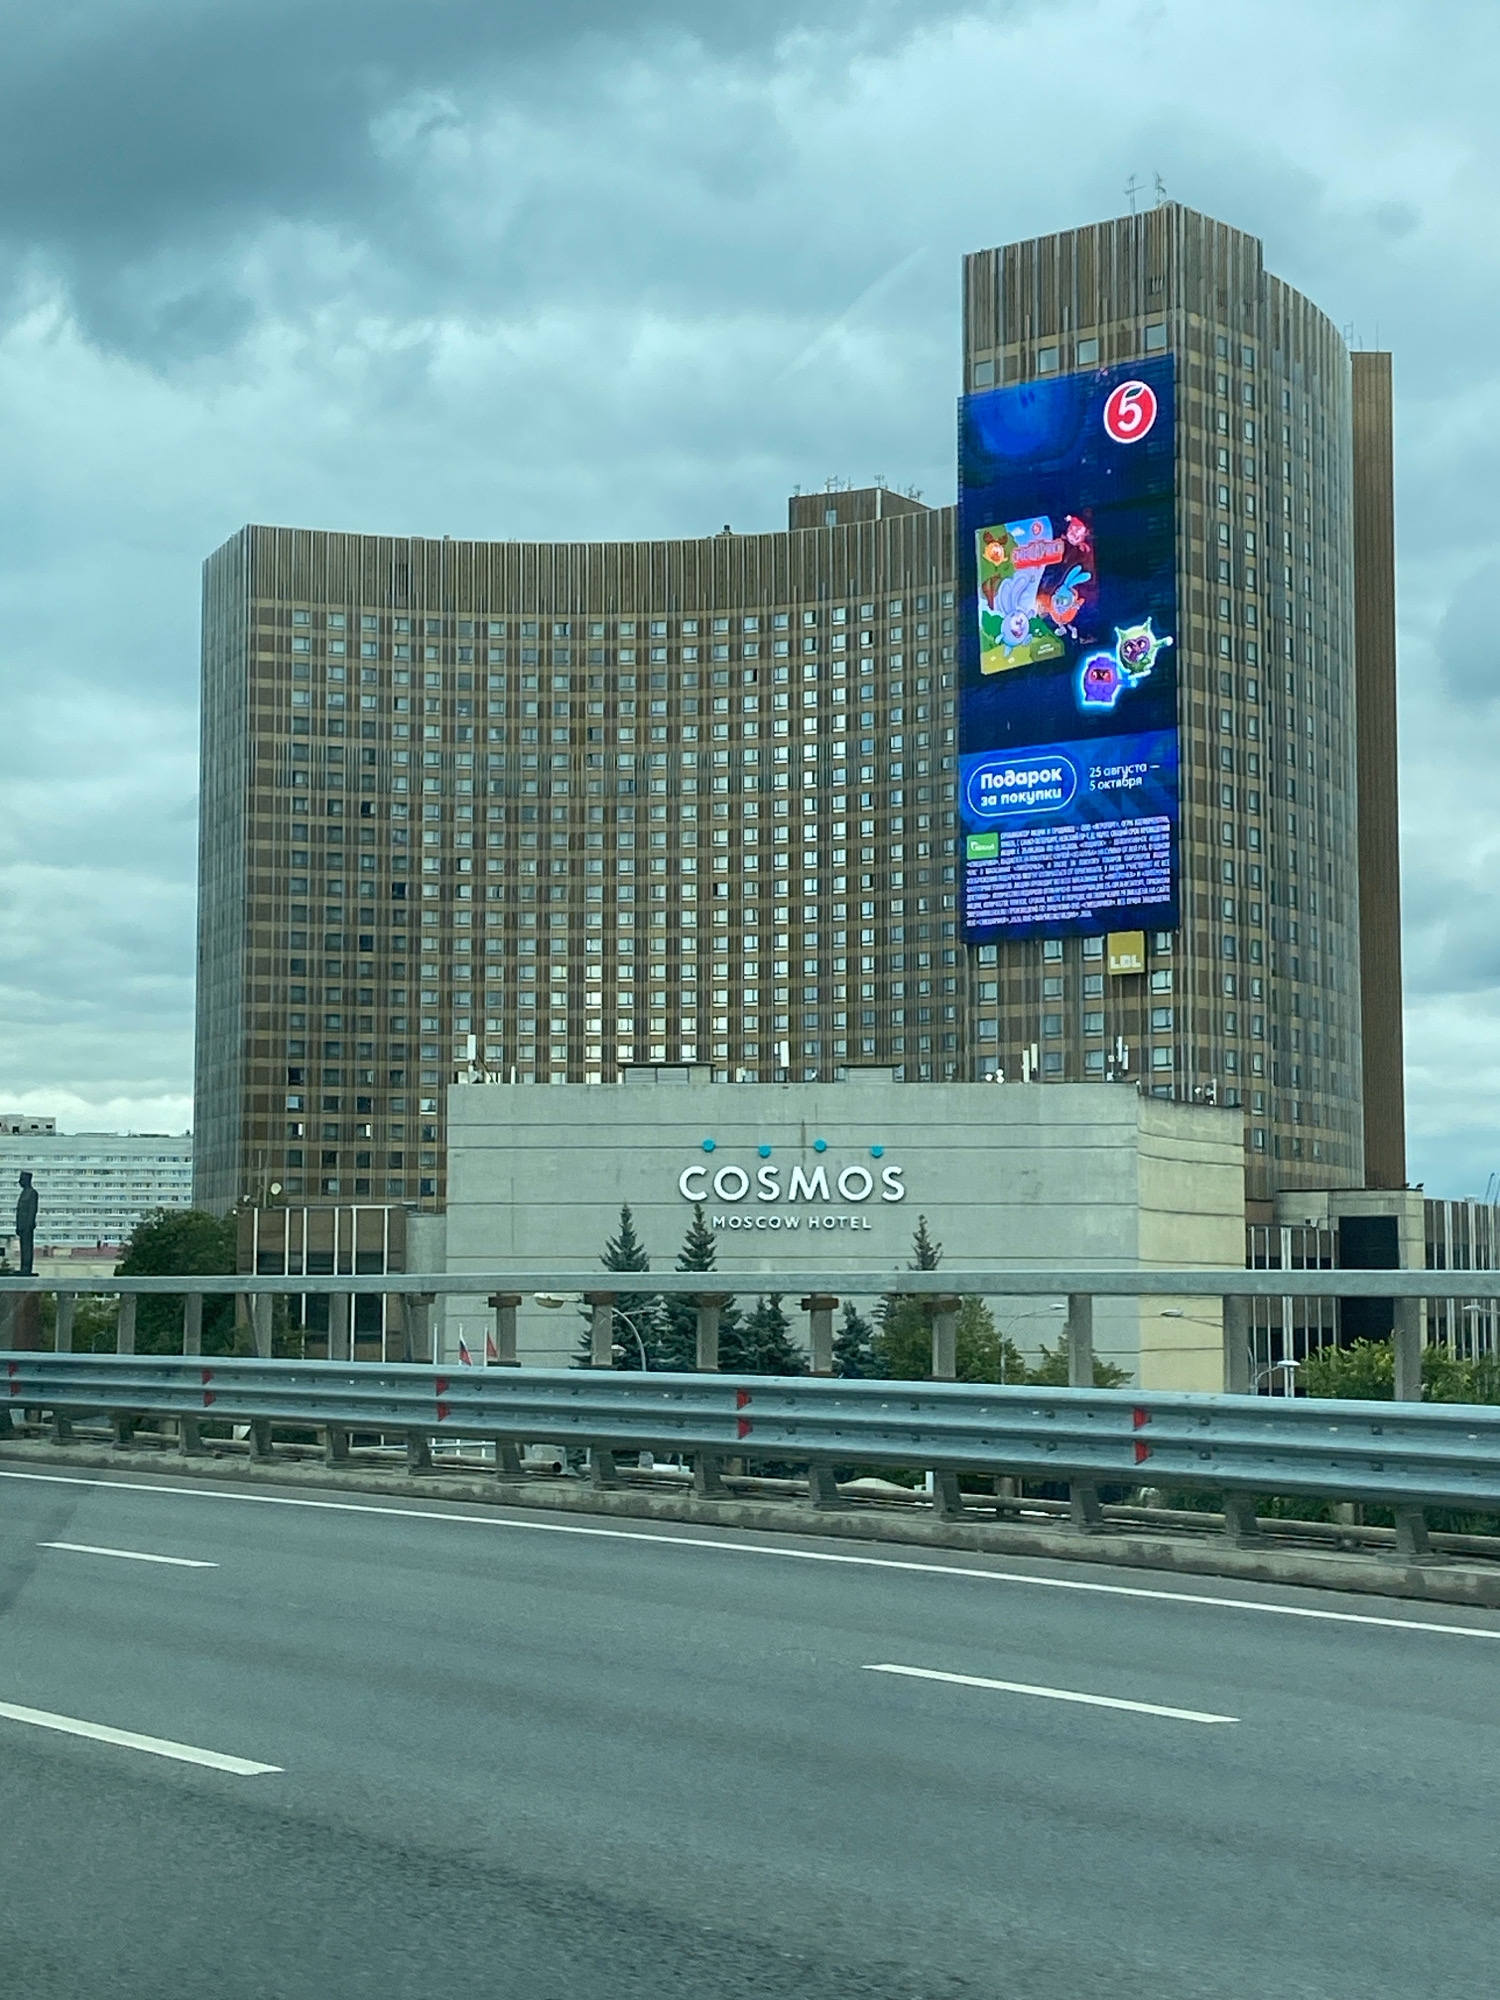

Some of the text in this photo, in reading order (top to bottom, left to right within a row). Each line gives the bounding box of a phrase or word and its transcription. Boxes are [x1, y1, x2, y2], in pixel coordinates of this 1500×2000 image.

[1117, 385, 1144, 432] 5
[981, 768, 1063, 790] Подарок
[1089, 766, 1102, 778] 25
[1103, 763, 1147, 778] августа
[1089, 776, 1143, 792] 5 октября
[981, 788, 1062, 807] за покупки
[679, 1165, 905, 1202] COSMOS
[712, 1215, 872, 1230] MOSCOW HOTEL
